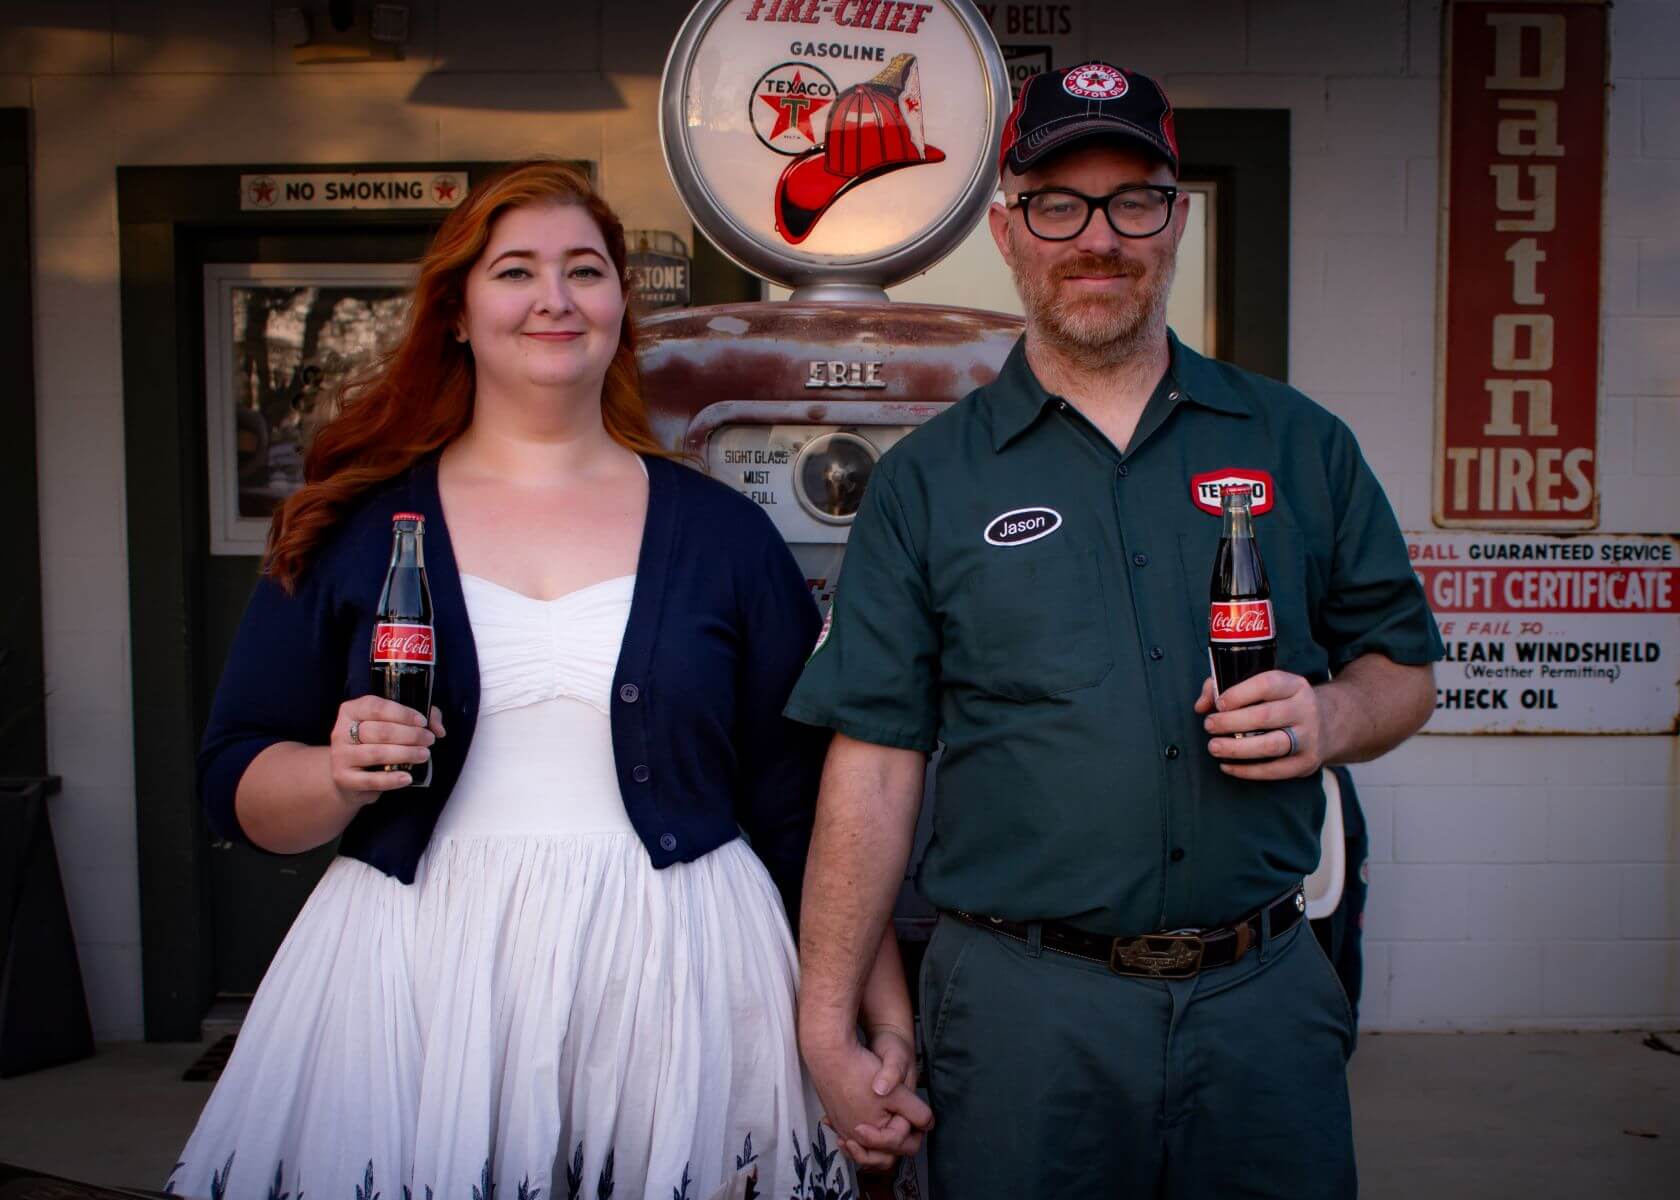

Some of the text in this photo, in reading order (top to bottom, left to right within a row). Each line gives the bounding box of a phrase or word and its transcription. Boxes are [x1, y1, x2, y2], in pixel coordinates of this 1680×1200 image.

[746, 0, 934, 34] FIRE-CHIEF
[1007, 5, 1072, 35] BELTS
[790, 42, 886, 62] GASOLINE
[765, 79, 832, 97] TEXACO
[781, 98, 810, 129] T
[286, 181, 424, 201] NO SMOKING
[1483, 12, 1567, 437] Dayton
[805, 360, 887, 388] ERIE
[725, 450, 752, 464] SIGHT
[744, 471, 770, 485] MUST
[1198, 481, 1265, 495] TEO
[1446, 447, 1595, 513] TIRES
[751, 491, 777, 505] FULL
[999, 516, 1046, 539] Jason
[1469, 544, 1594, 560] GUARANTEED
[1601, 545, 1672, 561] SERVICE
[1433, 570, 1673, 609] GIFT CERTIFICATE
[1467, 622, 1511, 635] FAIL
[377, 632, 431, 655] Coca-Cola
[1444, 642, 1661, 663] LEAN WINDSHIELD
[1521, 690, 1558, 709] OIL
